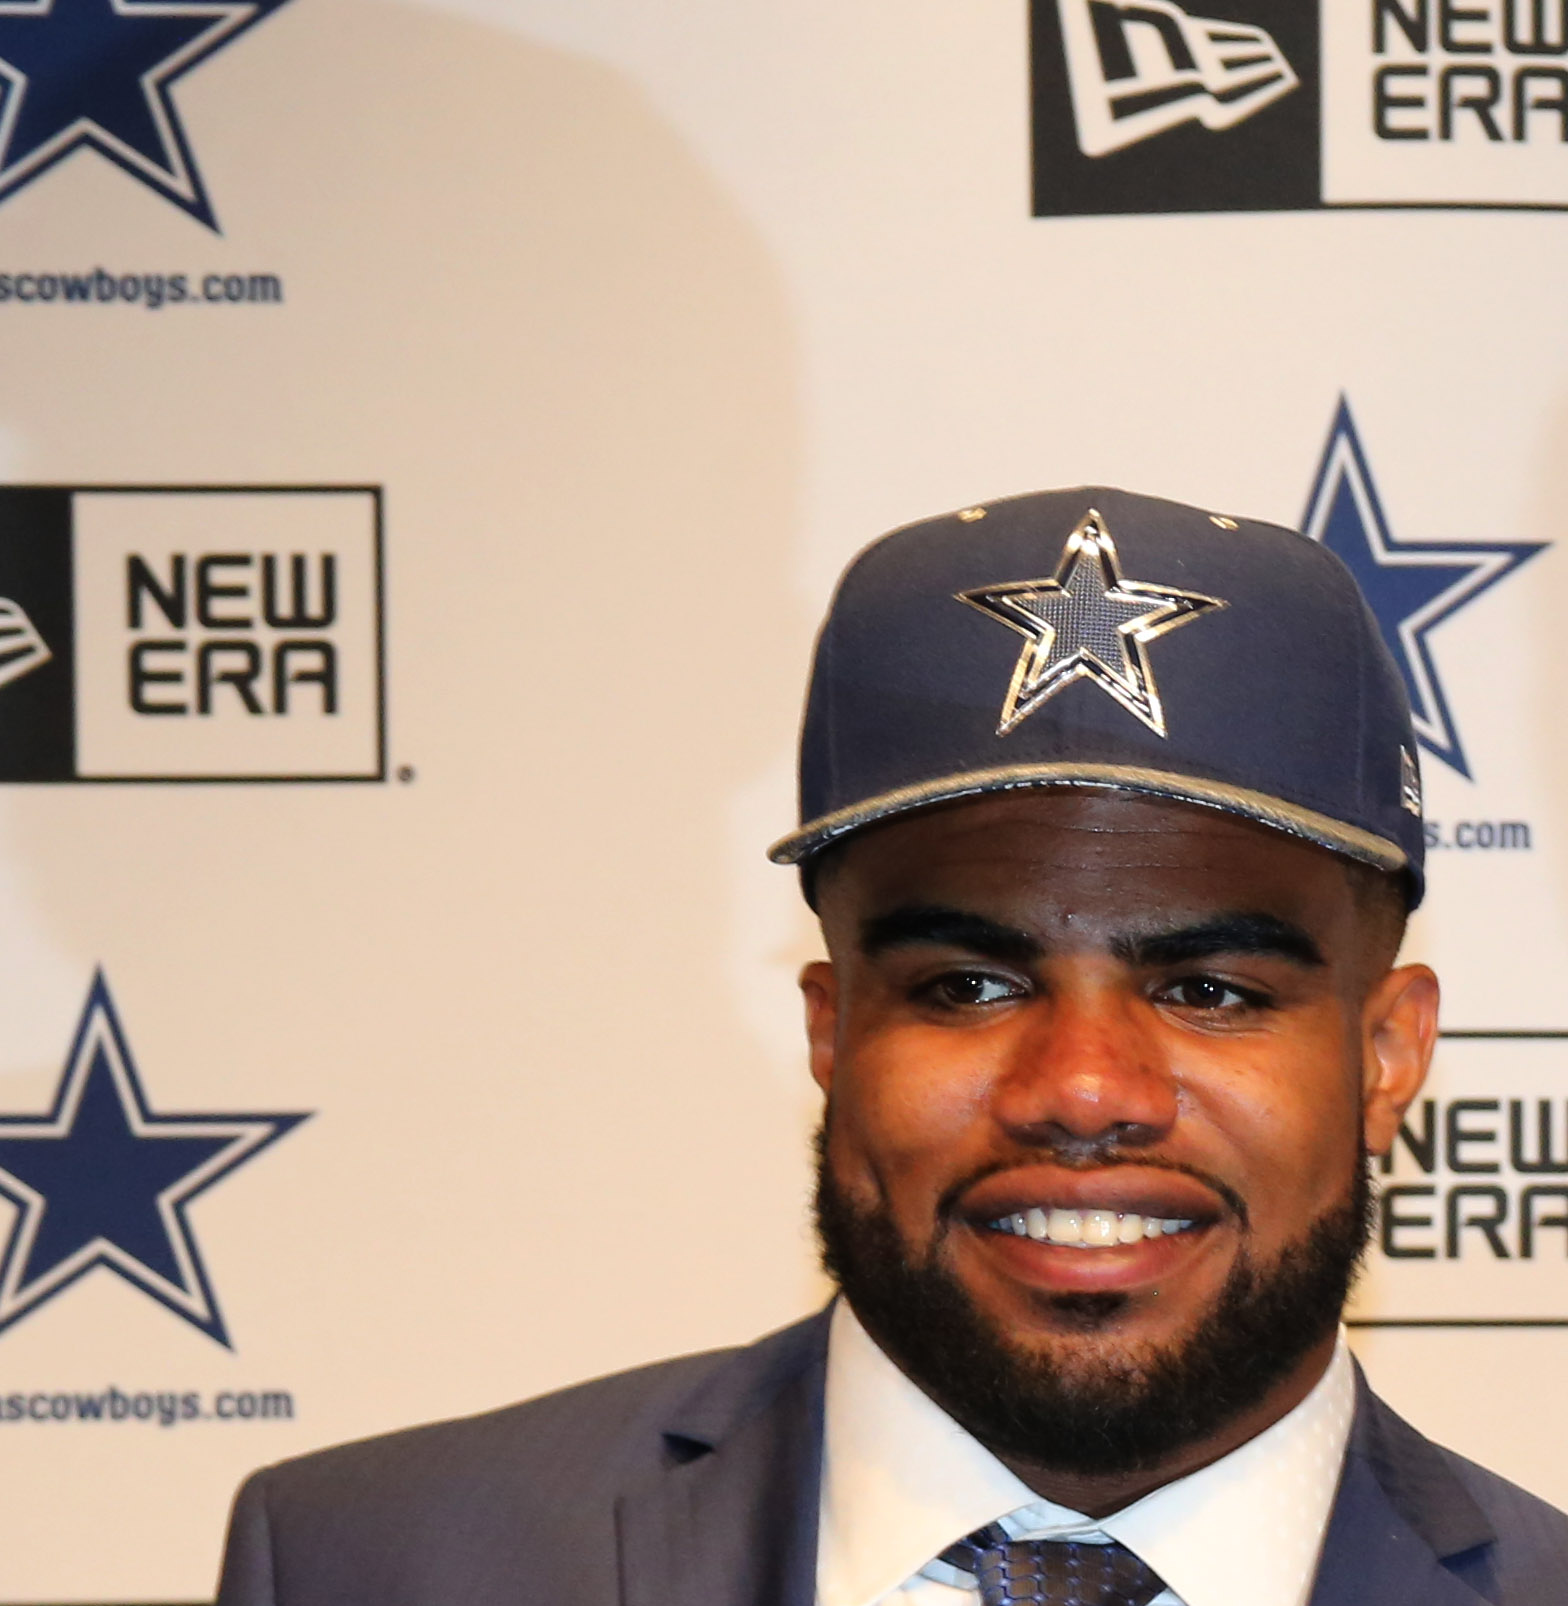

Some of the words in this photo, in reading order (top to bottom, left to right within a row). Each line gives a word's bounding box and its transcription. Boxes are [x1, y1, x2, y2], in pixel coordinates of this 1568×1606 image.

[126, 553, 337, 629] NEW
[128, 640, 338, 715] ERA
[0, 1386, 293, 1427] scowboys.com
